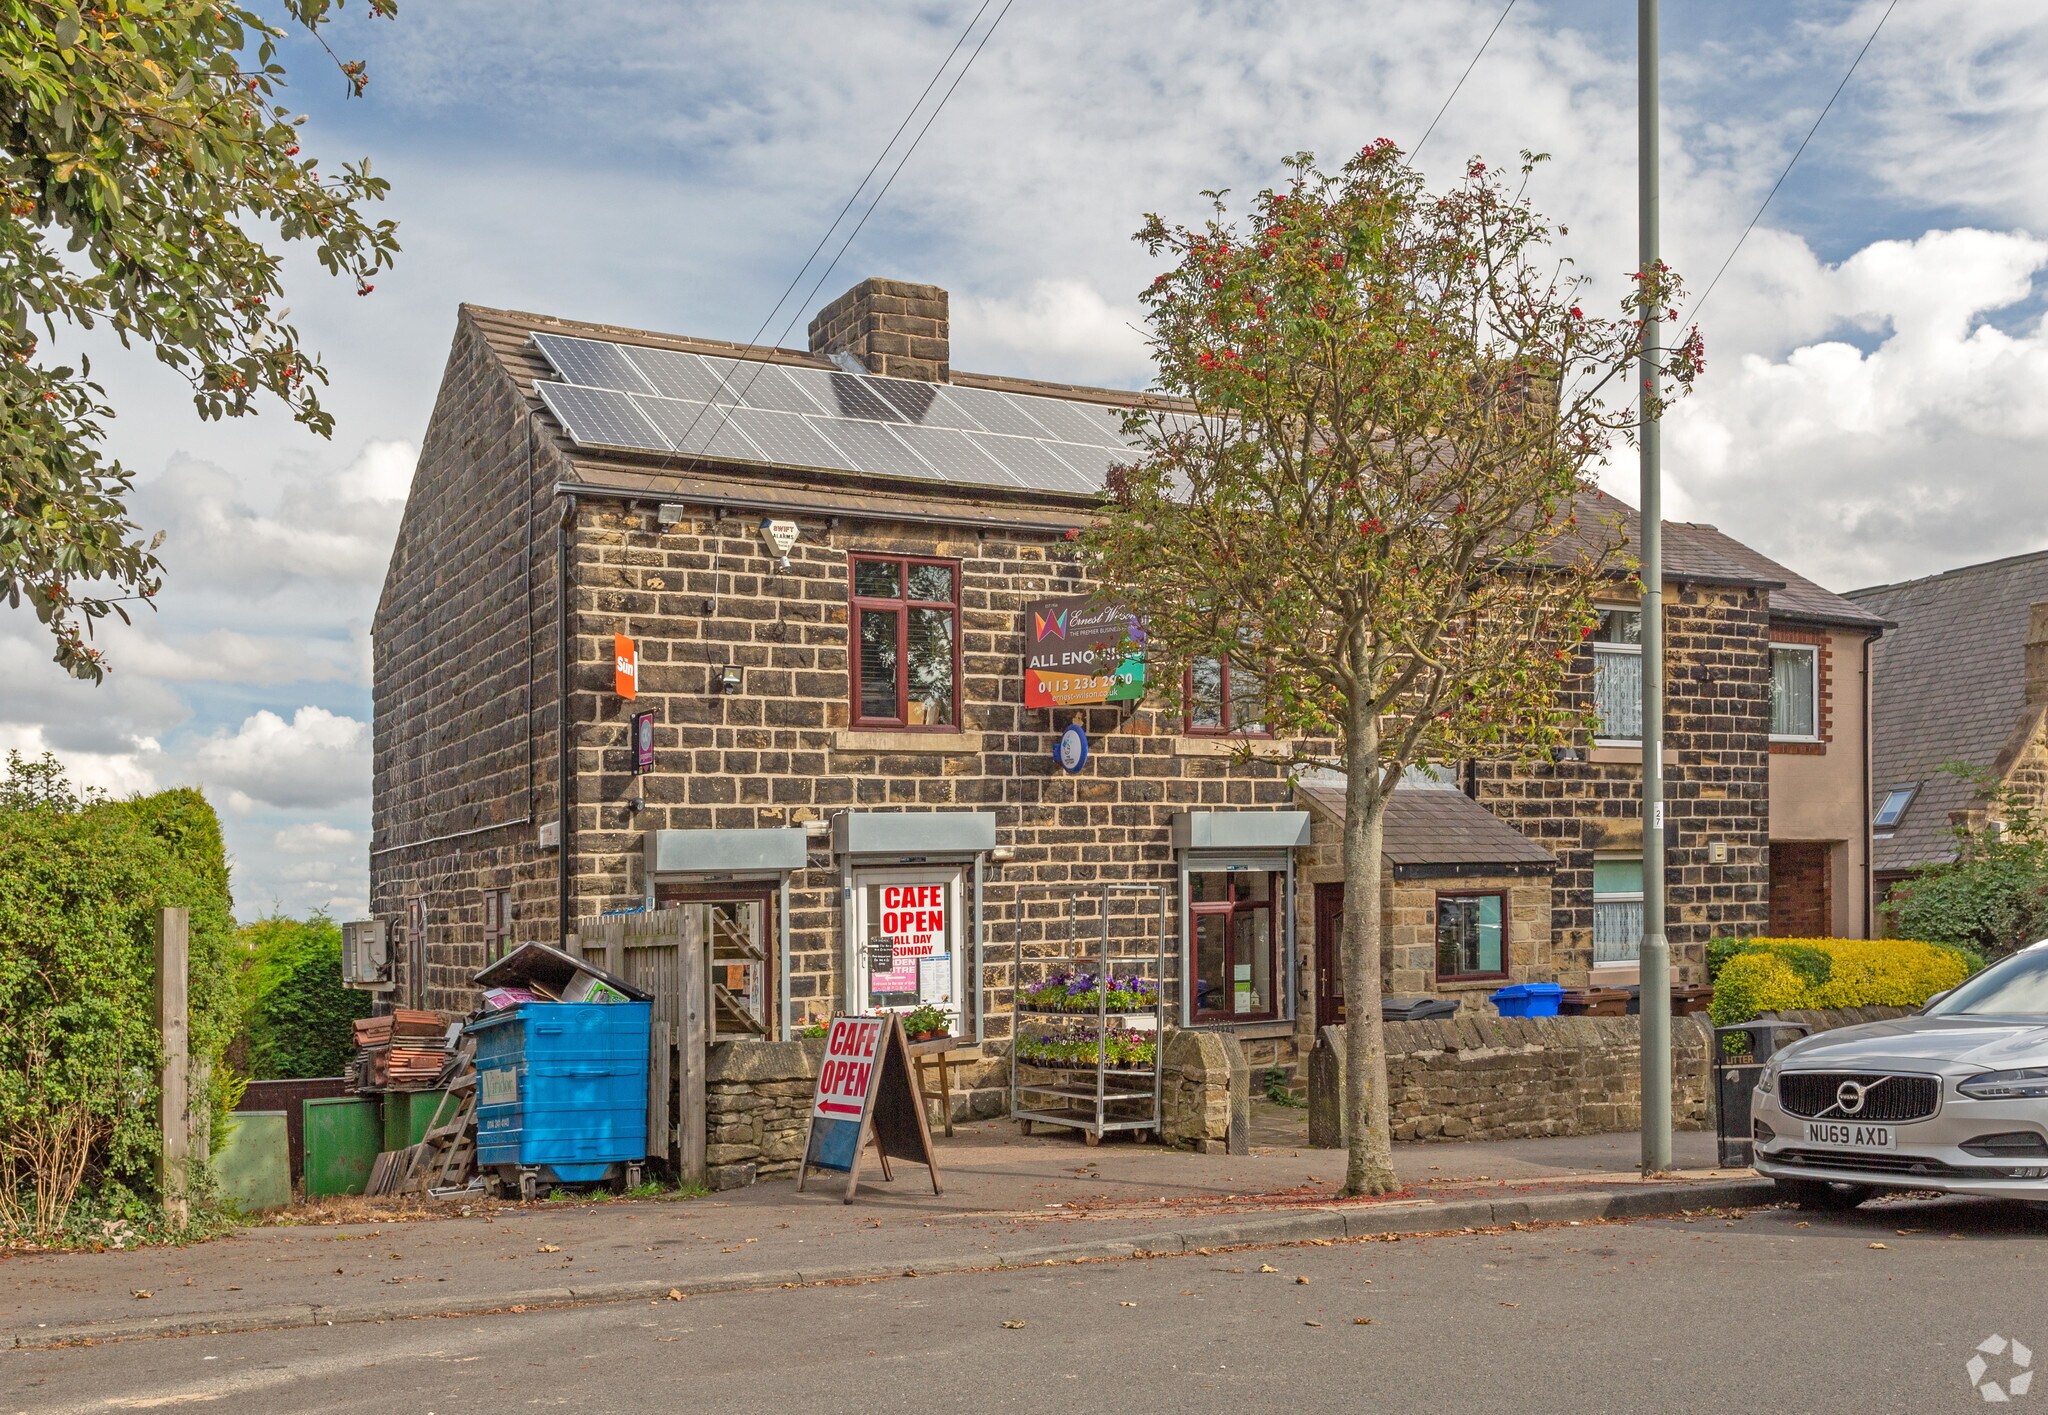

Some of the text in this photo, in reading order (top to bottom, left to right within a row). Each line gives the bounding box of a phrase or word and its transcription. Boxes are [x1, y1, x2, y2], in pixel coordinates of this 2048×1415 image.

[1070, 610, 1104, 627] Ernest
[617, 656, 634, 677] Sun
[1029, 654, 1058, 668] ALL
[1038, 679, 1069, 693] 0113
[1074, 677, 1097, 690] 238
[885, 886, 941, 909] CAFE
[883, 911, 943, 934] OPEN
[894, 934, 932, 945] ALL DAY
[893, 946, 933, 957] SUNDAY
[830, 1021, 879, 1057] CAFE
[1726, 1055, 1754, 1064] LITTER
[484, 1072, 513, 1098] Viridor
[820, 1059, 871, 1097] OPEN
[1810, 1124, 1888, 1146] NU69 AXD
